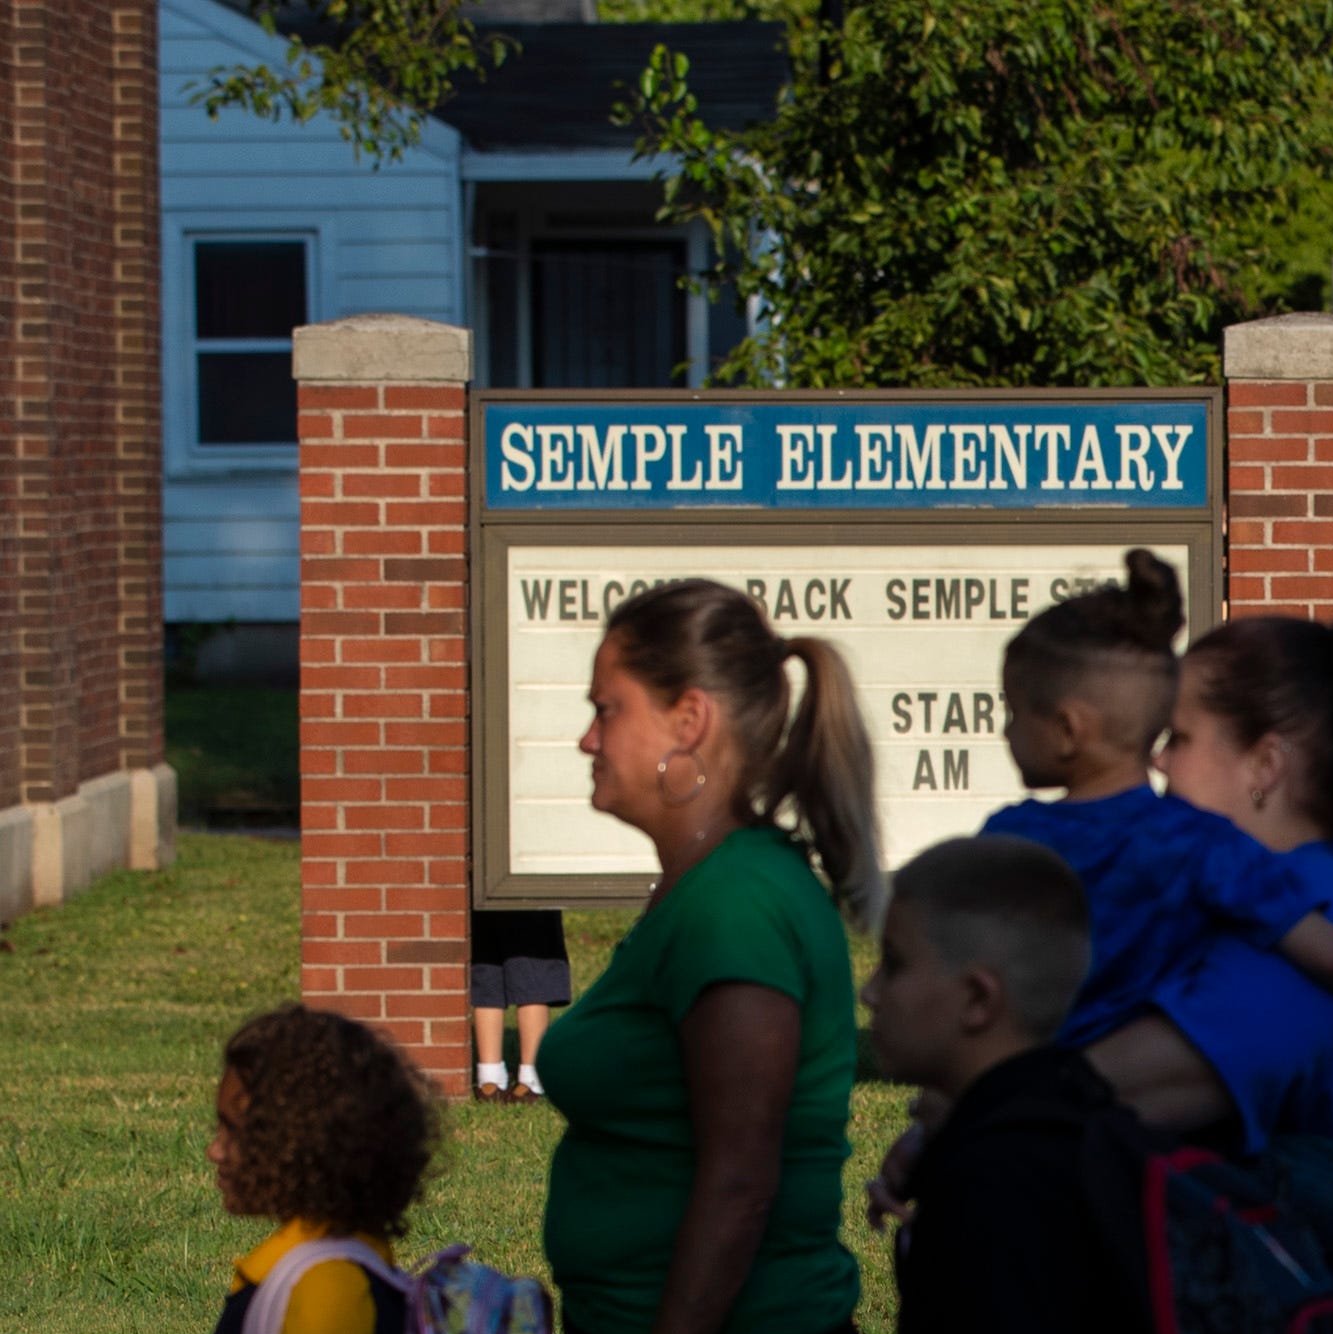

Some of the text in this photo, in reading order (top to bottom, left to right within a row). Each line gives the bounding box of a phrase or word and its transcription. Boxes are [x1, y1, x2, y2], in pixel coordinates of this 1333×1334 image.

[501, 422, 1194, 491] SEMPLE ELEMENTARY
[520, 578, 700, 620] WELC
[746, 578, 853, 620] BACK
[885, 578, 1029, 620] SEMPLE
[891, 692, 1005, 734] STAR
[912, 749, 969, 790] AM
